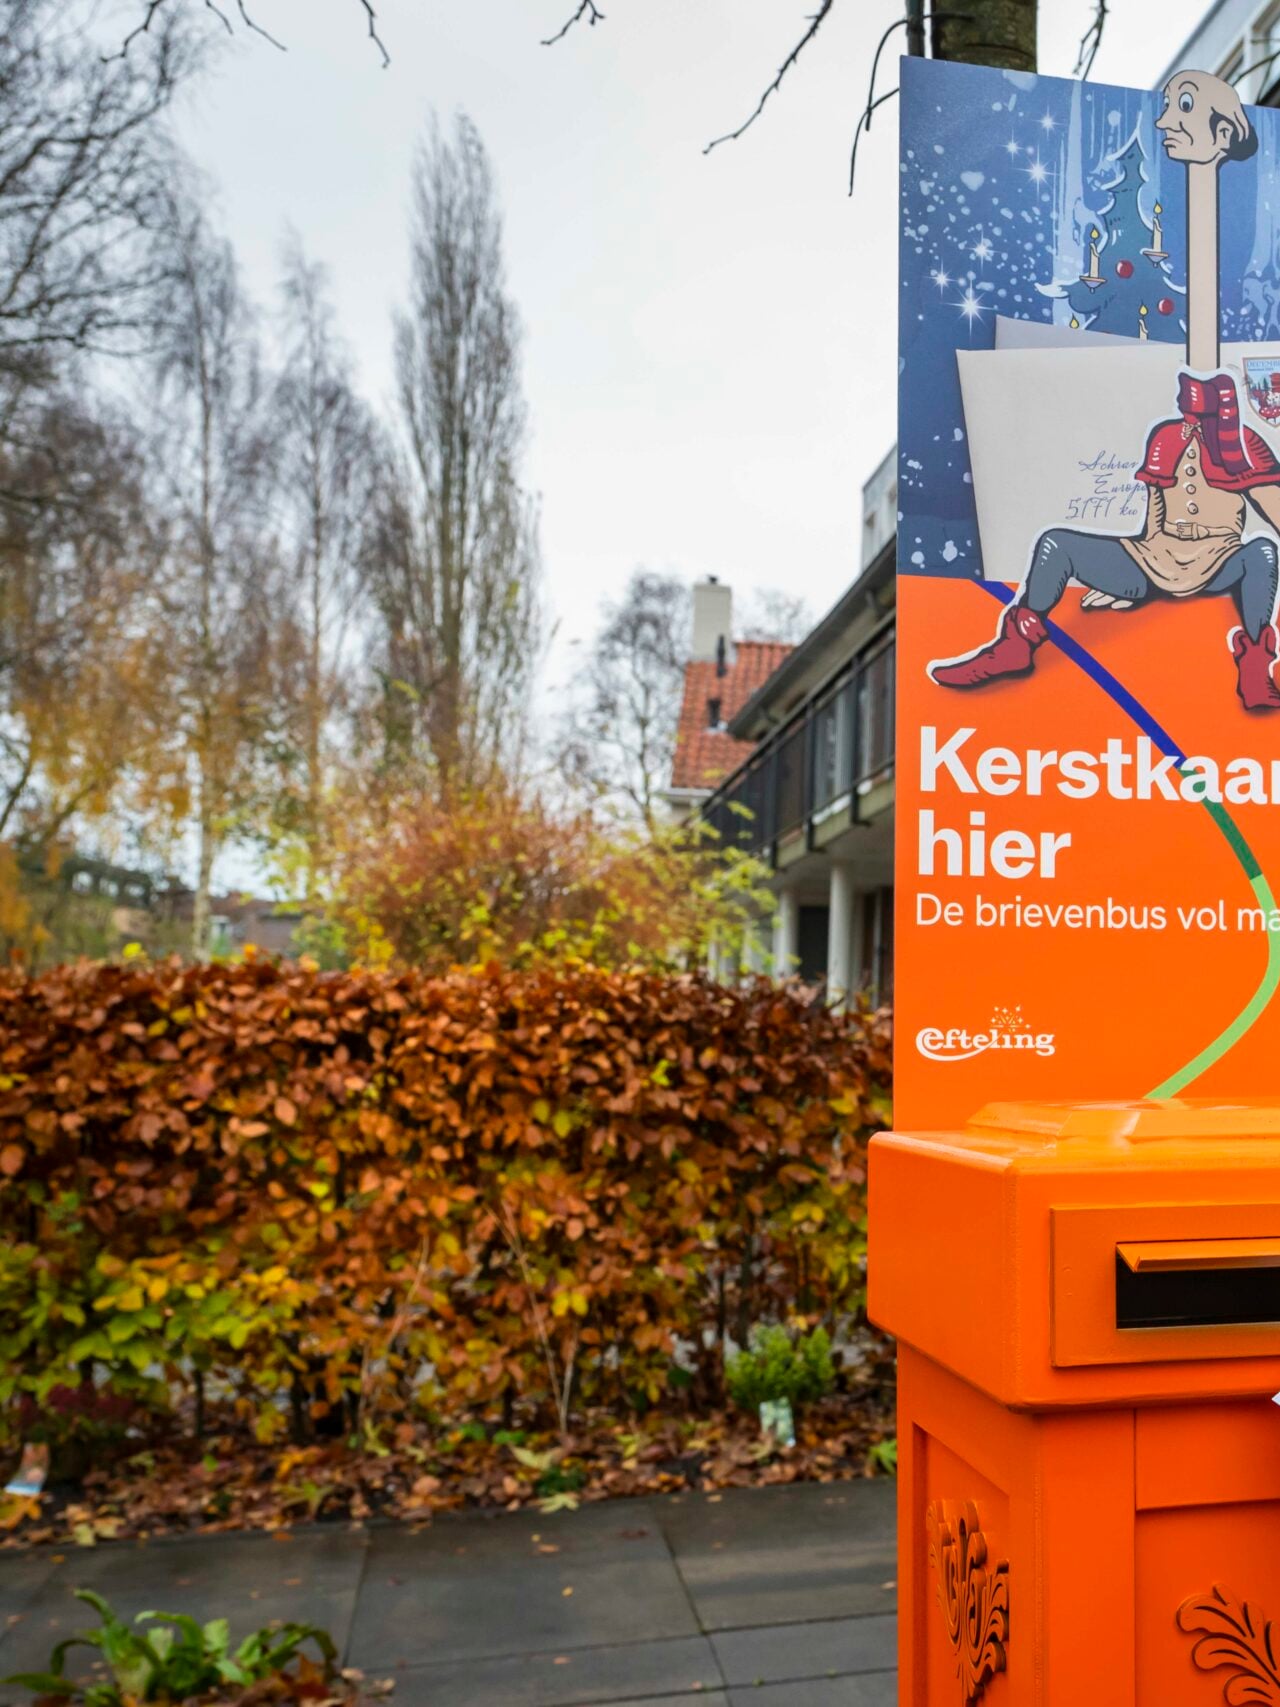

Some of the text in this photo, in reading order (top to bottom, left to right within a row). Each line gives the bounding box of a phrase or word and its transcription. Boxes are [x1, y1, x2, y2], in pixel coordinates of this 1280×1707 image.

[918, 809, 1072, 879] hier
[915, 893, 964, 927] De
[976, 895, 1168, 931] brievenbus
[1176, 901, 1228, 932] vol
